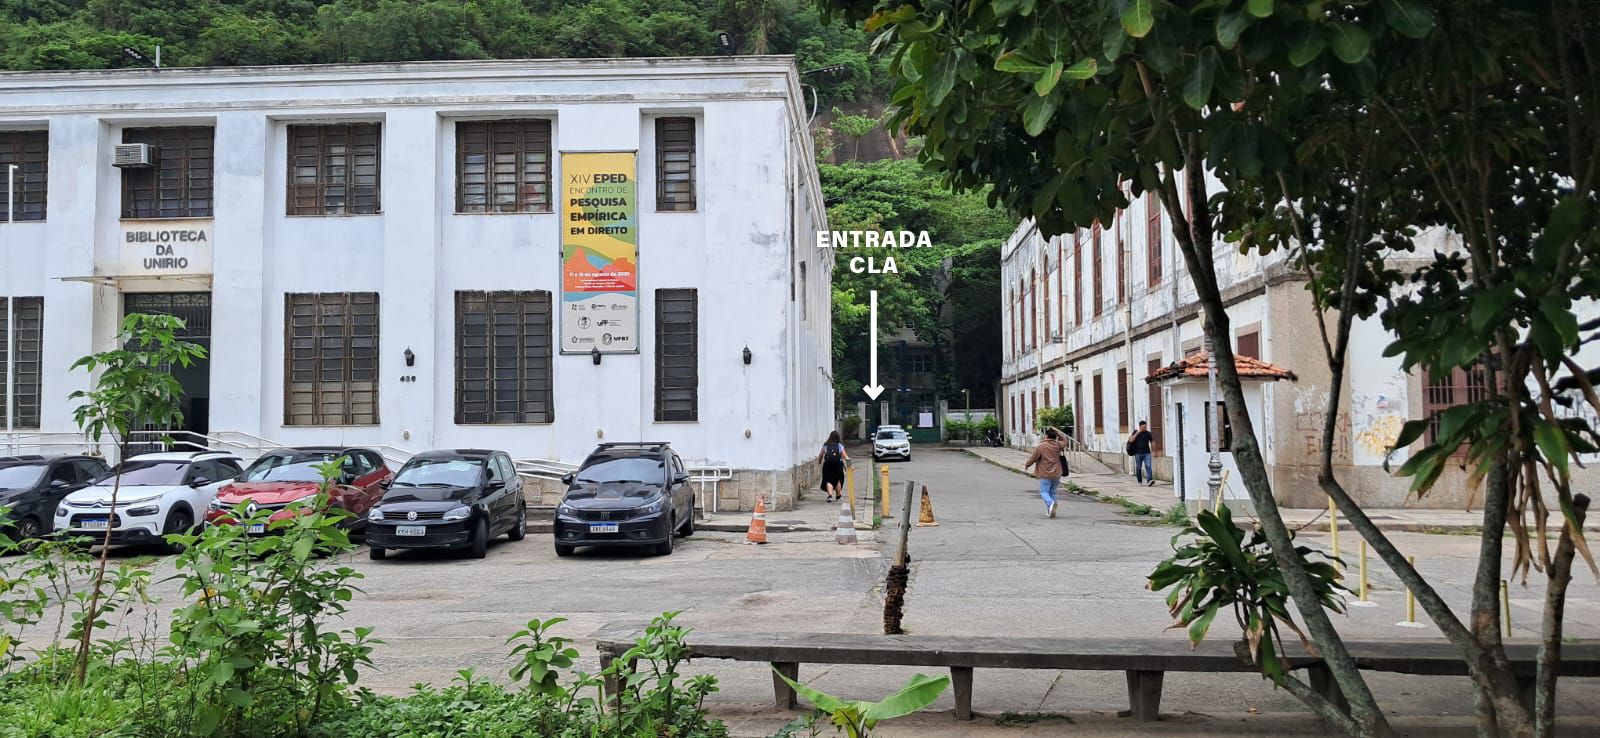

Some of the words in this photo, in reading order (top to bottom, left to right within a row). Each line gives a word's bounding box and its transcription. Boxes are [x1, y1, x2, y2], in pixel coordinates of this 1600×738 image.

[570, 174, 590, 184] XIV
[593, 173, 627, 184] EPED
[569, 186, 614, 194] ENCONTRO
[616, 186, 627, 194] DE
[570, 197, 627, 208] PESQUISA
[570, 209, 627, 221] EMPÍRICA
[570, 226, 585, 235] EM
[588, 226, 628, 235] DIREITO
[126, 230, 207, 243] BIBLIOTECA
[155, 244, 174, 256] DA
[143, 257, 188, 270] UNIRIO
